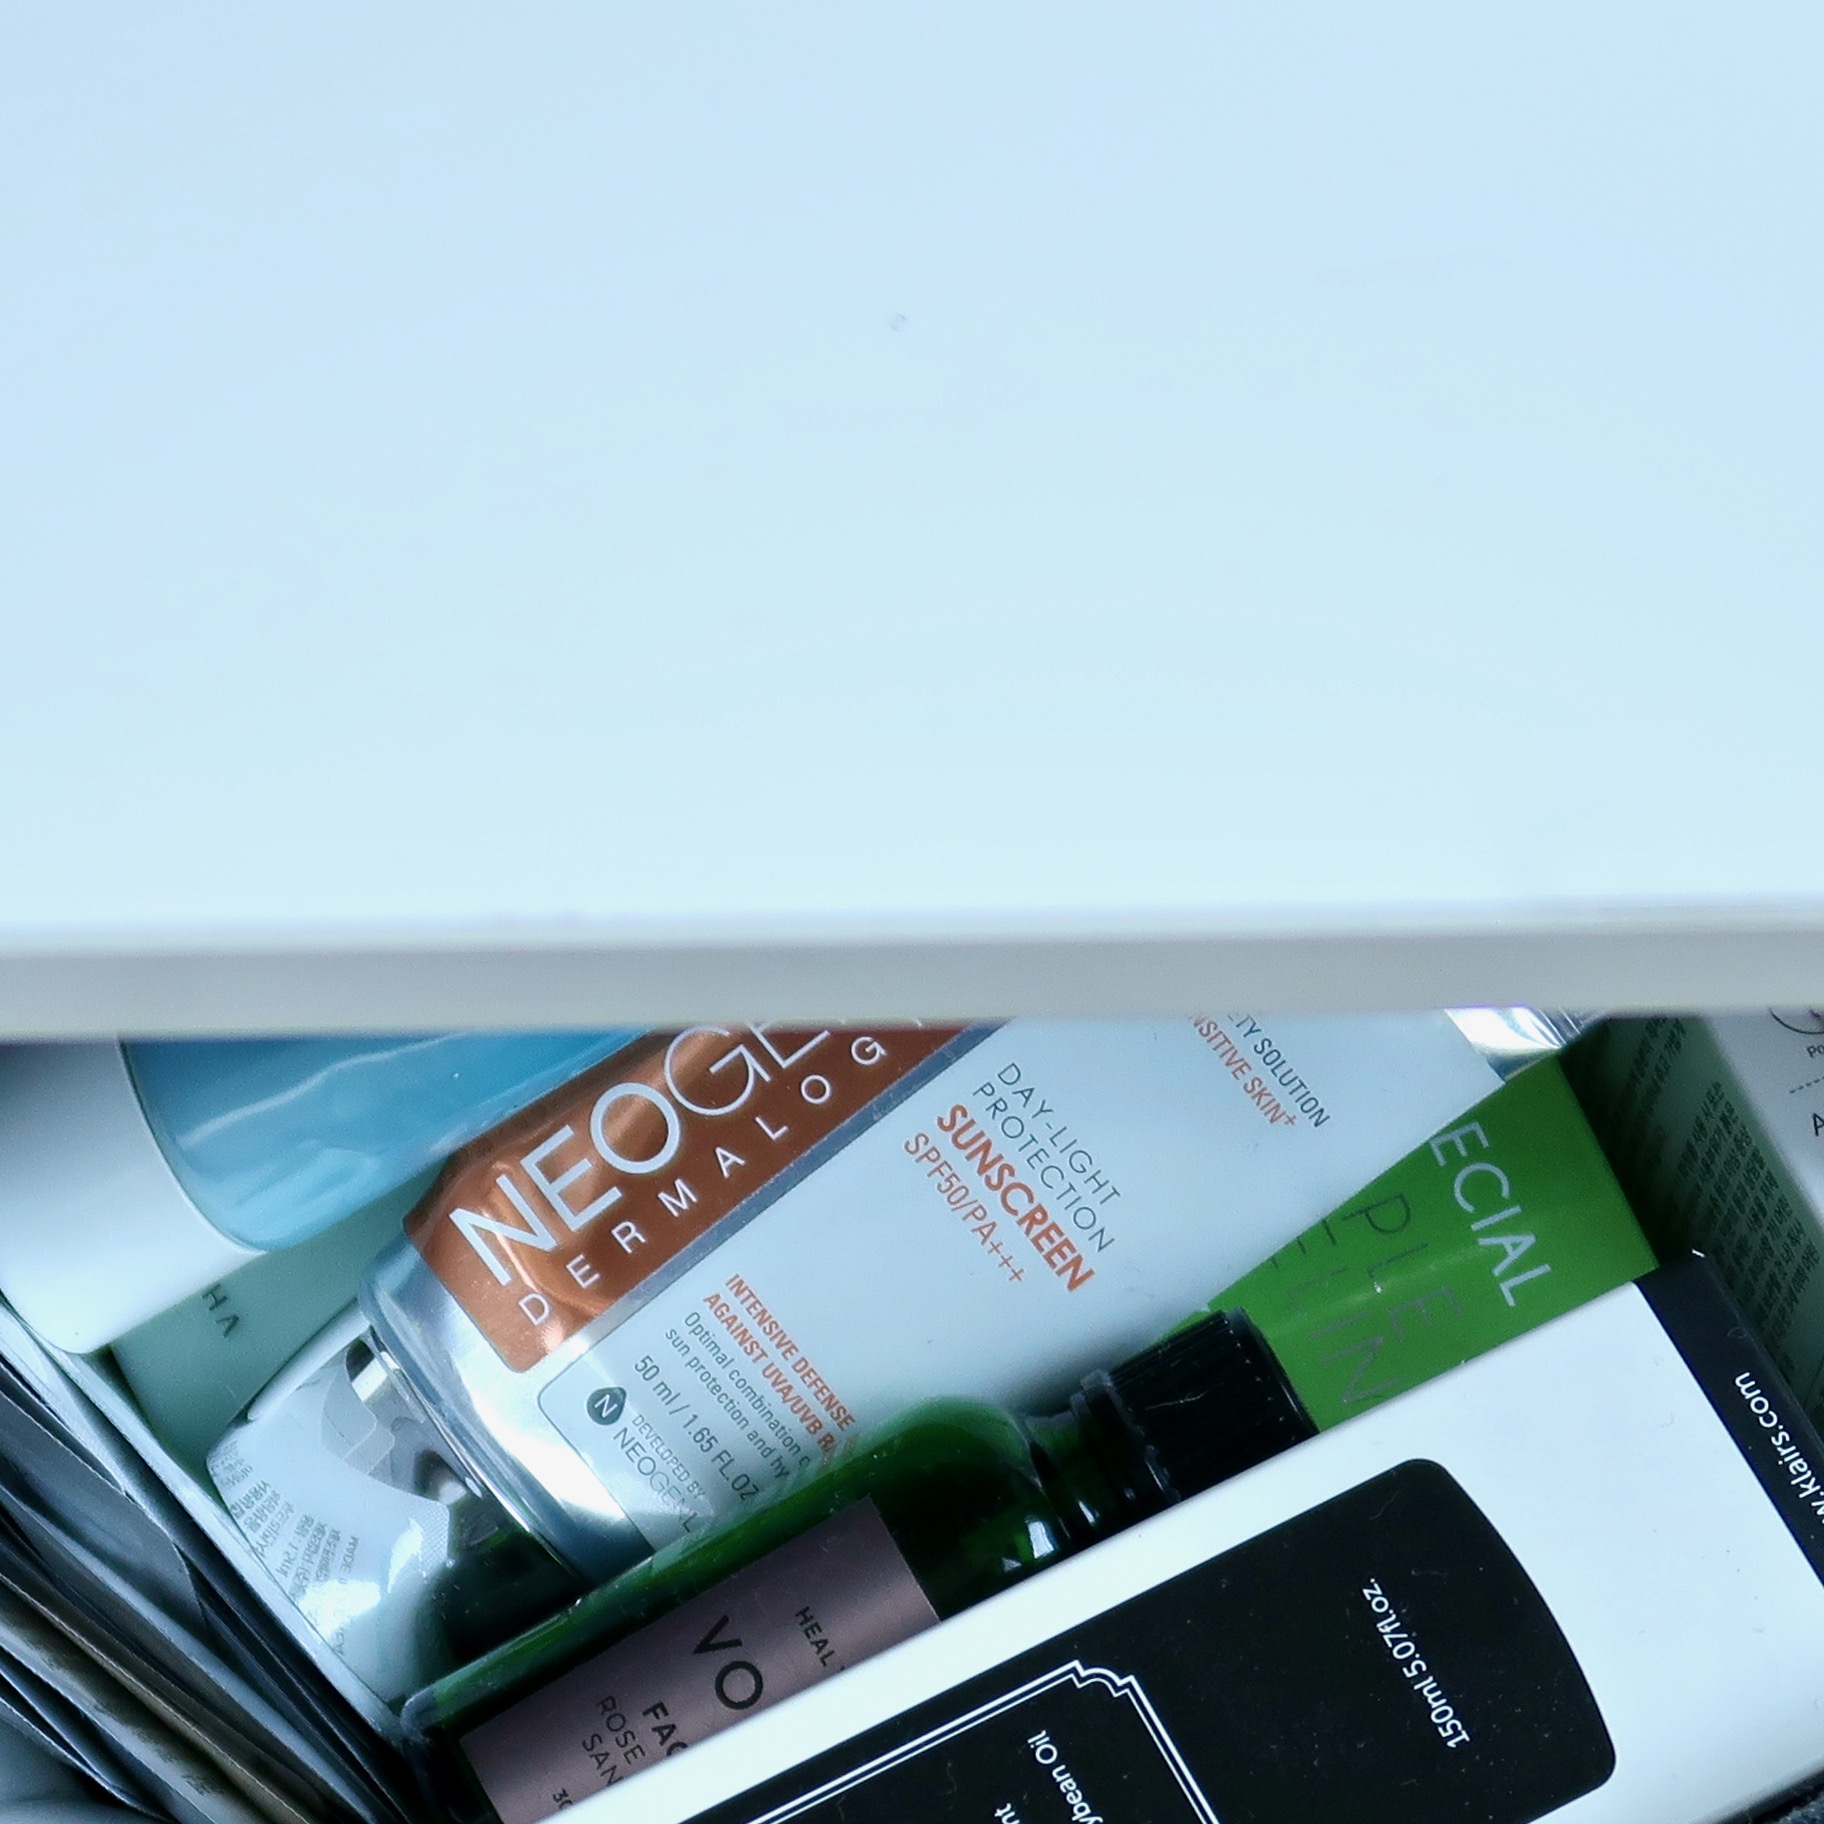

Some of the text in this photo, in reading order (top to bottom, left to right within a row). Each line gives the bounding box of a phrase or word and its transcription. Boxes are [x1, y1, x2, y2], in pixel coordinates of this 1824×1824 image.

[997, 1062, 1120, 1204] DAY-LIGHT
[1226, 1005, 1330, 1127] TY SOLUTION
[517, 1030, 886, 1325] DERMALOG
[904, 1132, 1024, 1281] SPF50/PA+++
[937, 1104, 1094, 1291] SUNSCREEN
[972, 1081, 1114, 1252] PROTECTION
[634, 1355, 659, 1381] 50
[652, 1380, 680, 1405] ml
[682, 1414, 718, 1452] 1.65
[665, 1328, 690, 1356] sun
[684, 1356, 749, 1429] protection
[746, 1429, 776, 1458] and
[684, 1311, 801, 1457] Optimal combination
[702, 1293, 768, 1363] AGAINST
[761, 1361, 822, 1435] UVA/UVB
[724, 1273, 854, 1431] INTENSIVE DEFENSE
[631, 1413, 705, 1499] DEVELOPED BY
[693, 1617, 763, 1710] VO
[795, 1606, 835, 1667] HEAL
[1362, 1578, 1469, 1747] 150ml 5.07fl.oz.
[601, 1697, 645, 1765] ROSE
[1027, 1730, 1057, 1764] Oil
